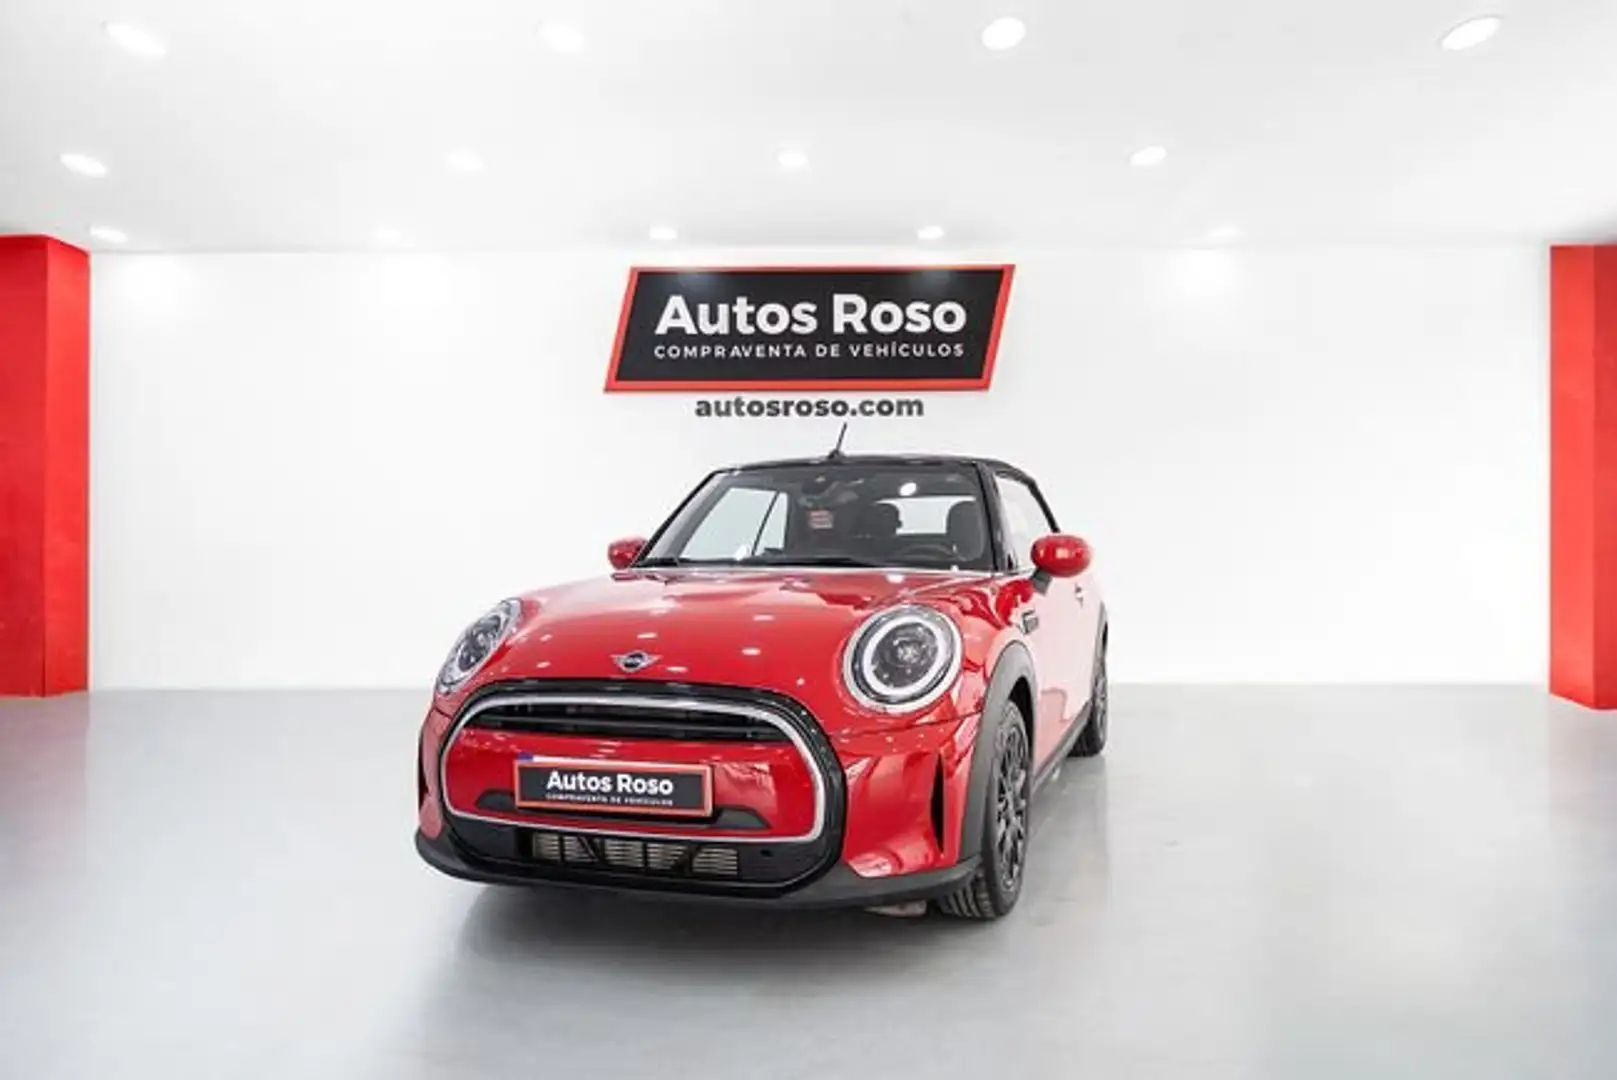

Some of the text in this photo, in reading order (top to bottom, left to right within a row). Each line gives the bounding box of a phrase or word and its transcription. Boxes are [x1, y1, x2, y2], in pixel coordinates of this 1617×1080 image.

[654, 293, 967, 336] Autos Roso
[654, 341, 965, 359] COMPRAVENTA DE VEHÍCULOS
[695, 397, 924, 418] autosroso.com
[547, 770, 674, 795] Autos Roso
